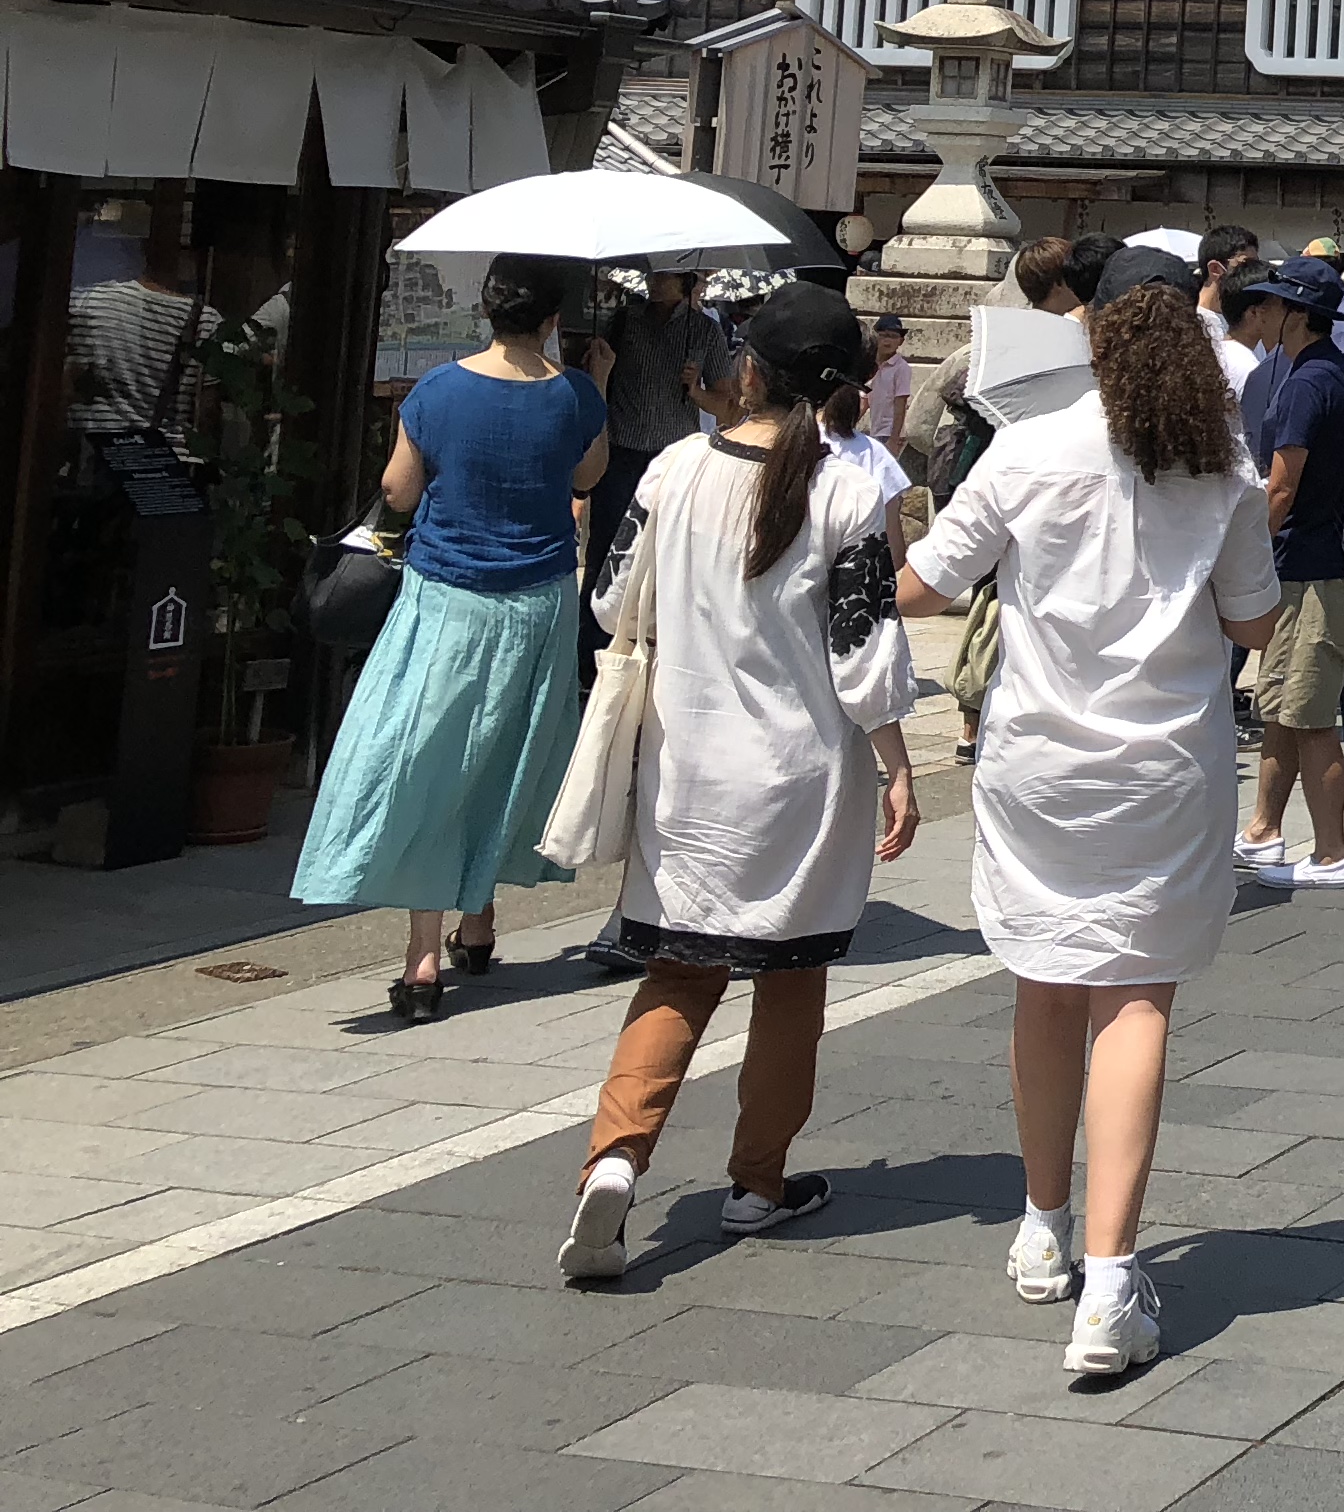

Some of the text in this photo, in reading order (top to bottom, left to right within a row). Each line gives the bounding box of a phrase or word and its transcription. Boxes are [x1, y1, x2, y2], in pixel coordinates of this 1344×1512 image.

[769, 52, 803, 185] おかげ横丁
[805, 47, 823, 170] これより
